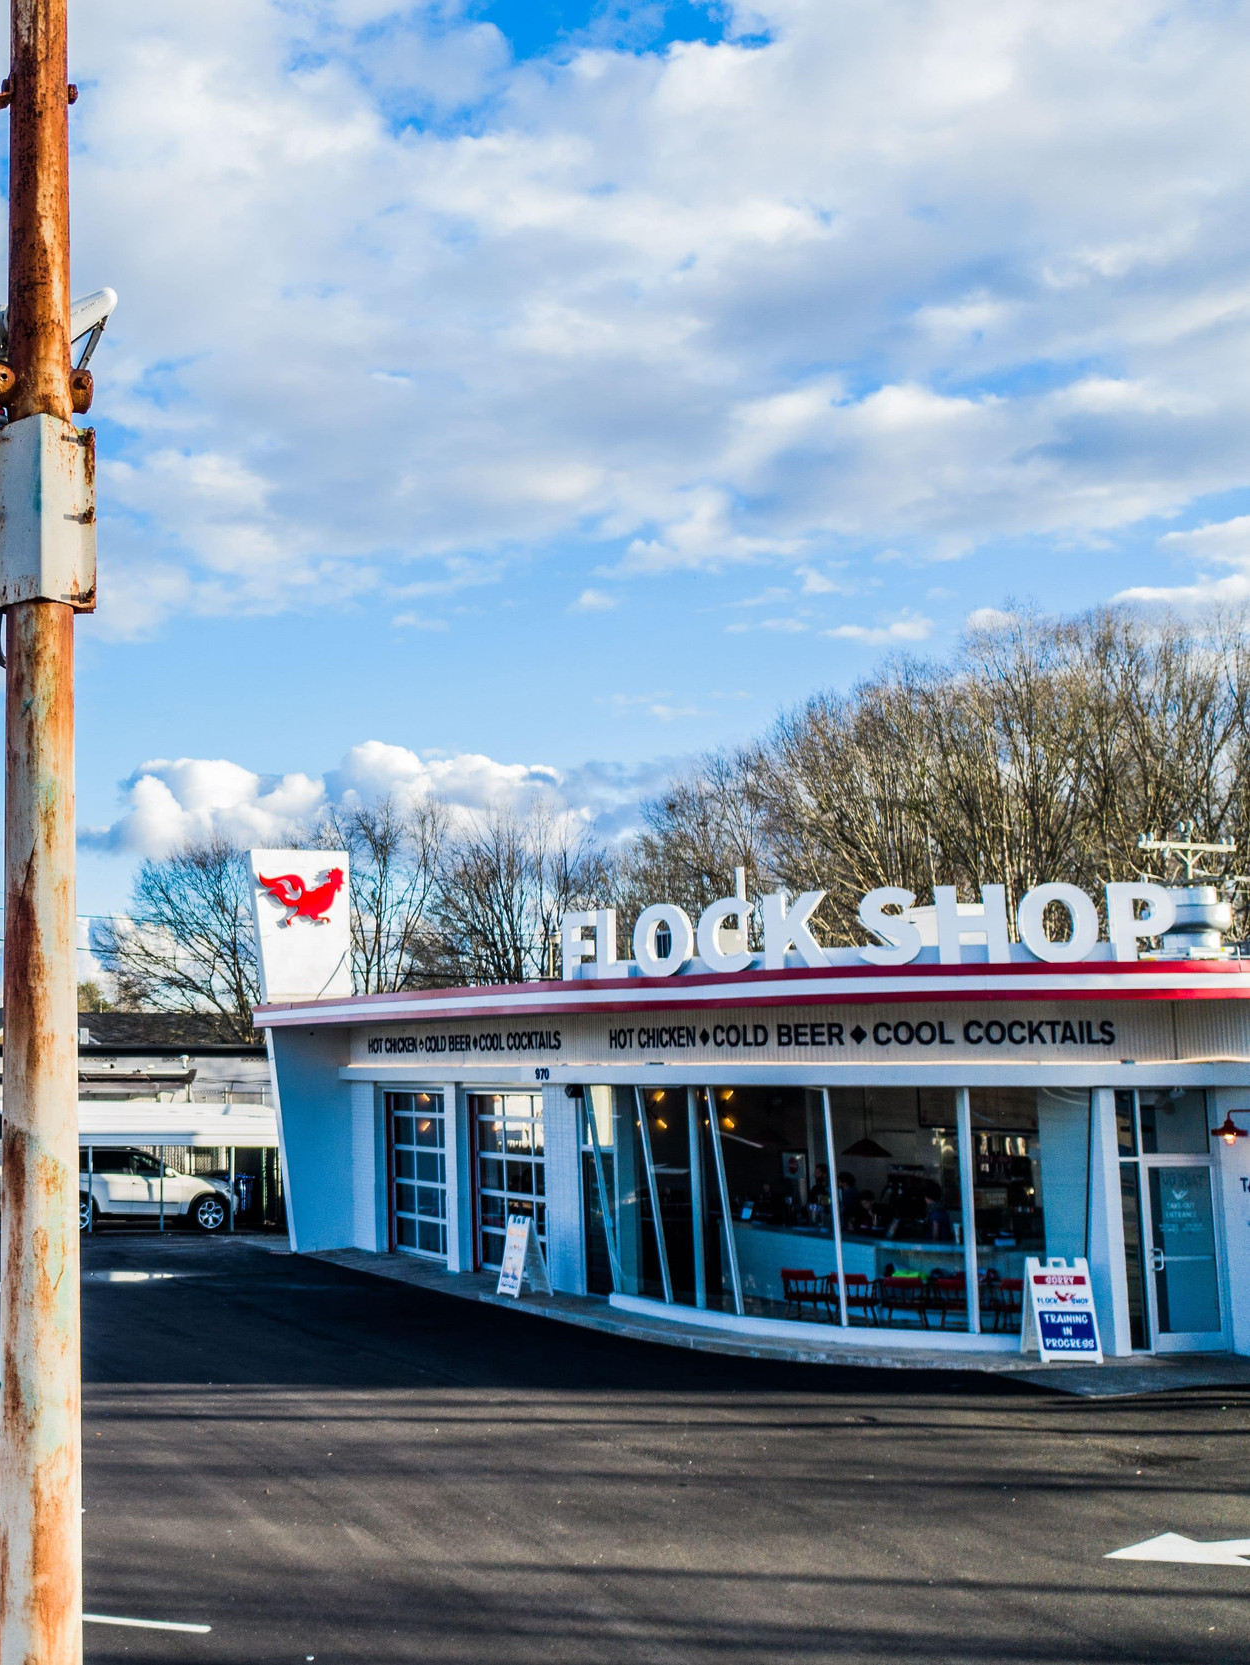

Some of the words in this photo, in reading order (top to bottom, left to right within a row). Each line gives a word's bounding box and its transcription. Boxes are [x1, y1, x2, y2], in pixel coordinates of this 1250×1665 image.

[562, 890, 833, 981] FLOCK
[858, 881, 1177, 966] SHOP
[609, 1027, 635, 1050] HOT
[638, 1026, 696, 1049] CHICKEN
[712, 1024, 769, 1048] COLD
[776, 1022, 845, 1047] BEER
[873, 1020, 955, 1046] COOL
[963, 1019, 1116, 1046] COCKTAILS
[368, 1036, 383, 1054] HOT
[385, 1037, 418, 1053] CHICKEN
[425, 1035, 447, 1053] COLD
[449, 1034, 471, 1052] BEER
[479, 1033, 505, 1051] COOL
[507, 1030, 562, 1051] COCKTAILS
[535, 1068, 550, 1081] 970
[1043, 1313, 1089, 1324] TRAINING
[1062, 1326, 1073, 1336] IN
[1045, 1338, 1095, 1349] PROGRESS
